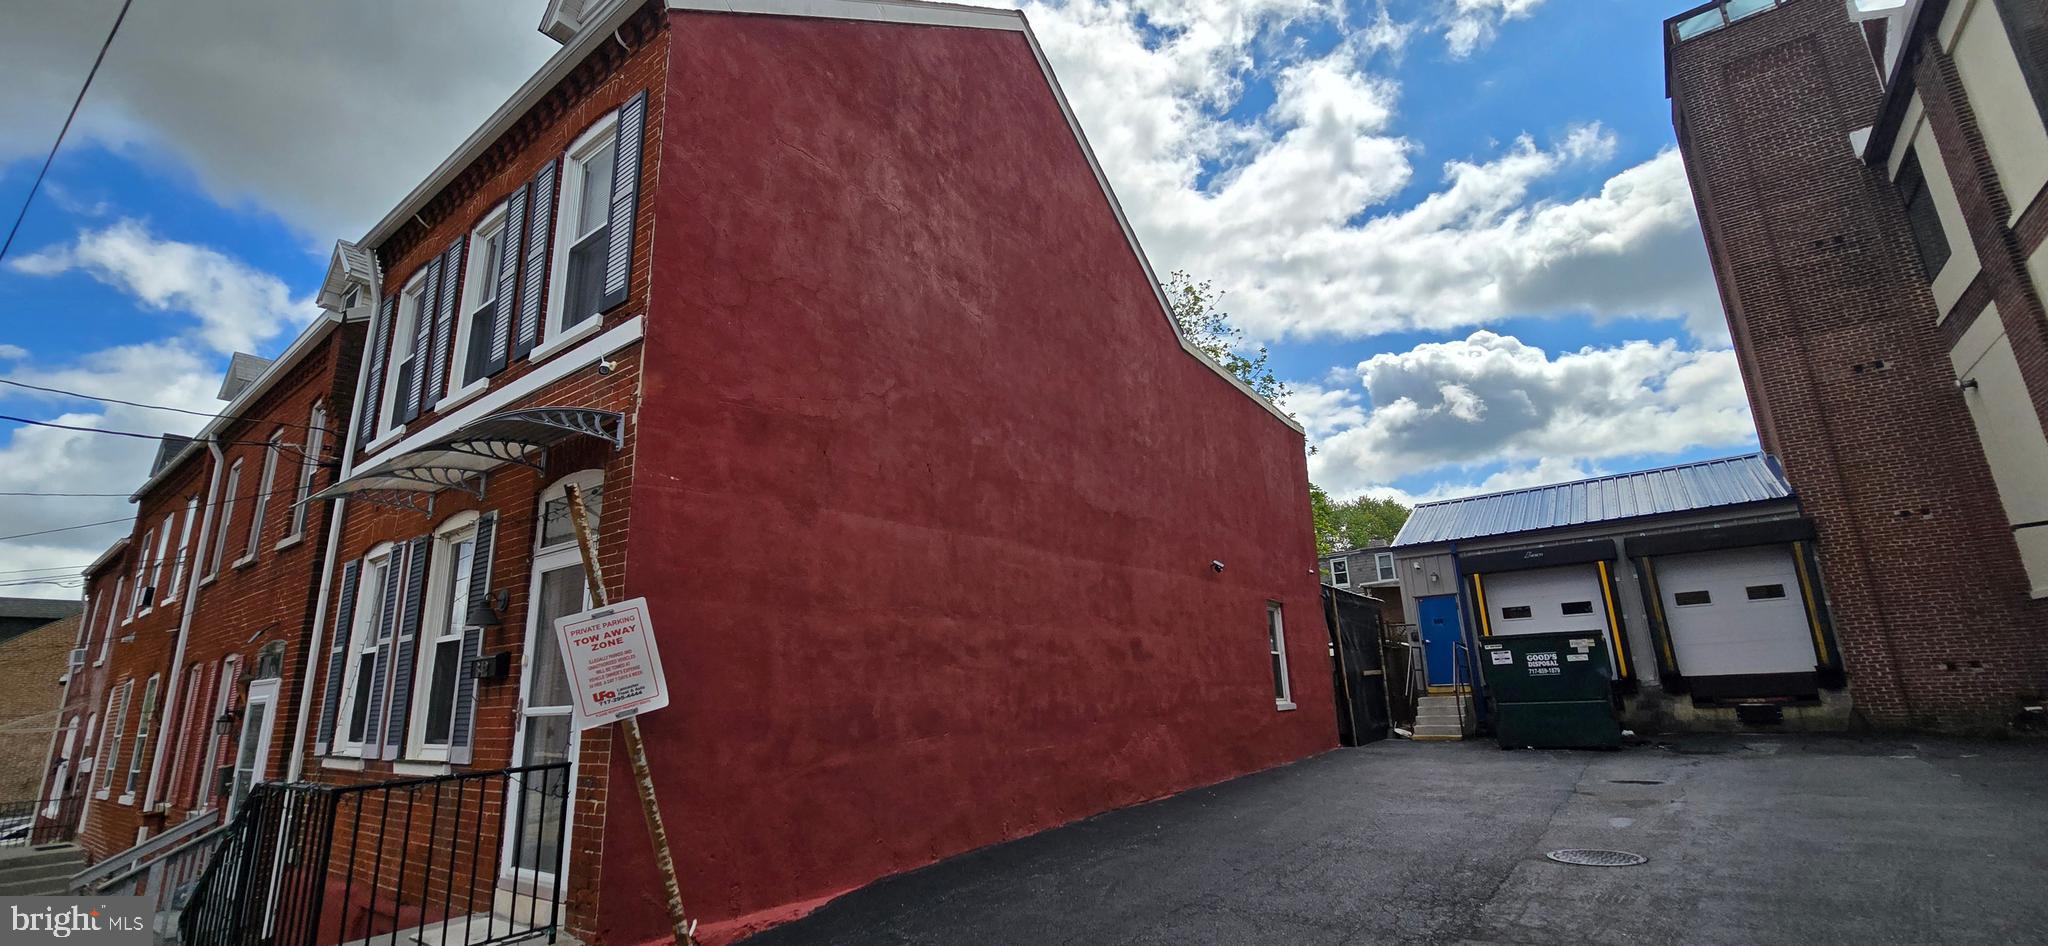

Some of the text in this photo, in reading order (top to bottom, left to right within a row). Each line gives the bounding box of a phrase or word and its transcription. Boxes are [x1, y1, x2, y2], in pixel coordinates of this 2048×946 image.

[571, 615, 635, 636] PRIVATE PARKING
[574, 625, 636, 646] TOW AWAY
[591, 637, 624, 651] ZONE
